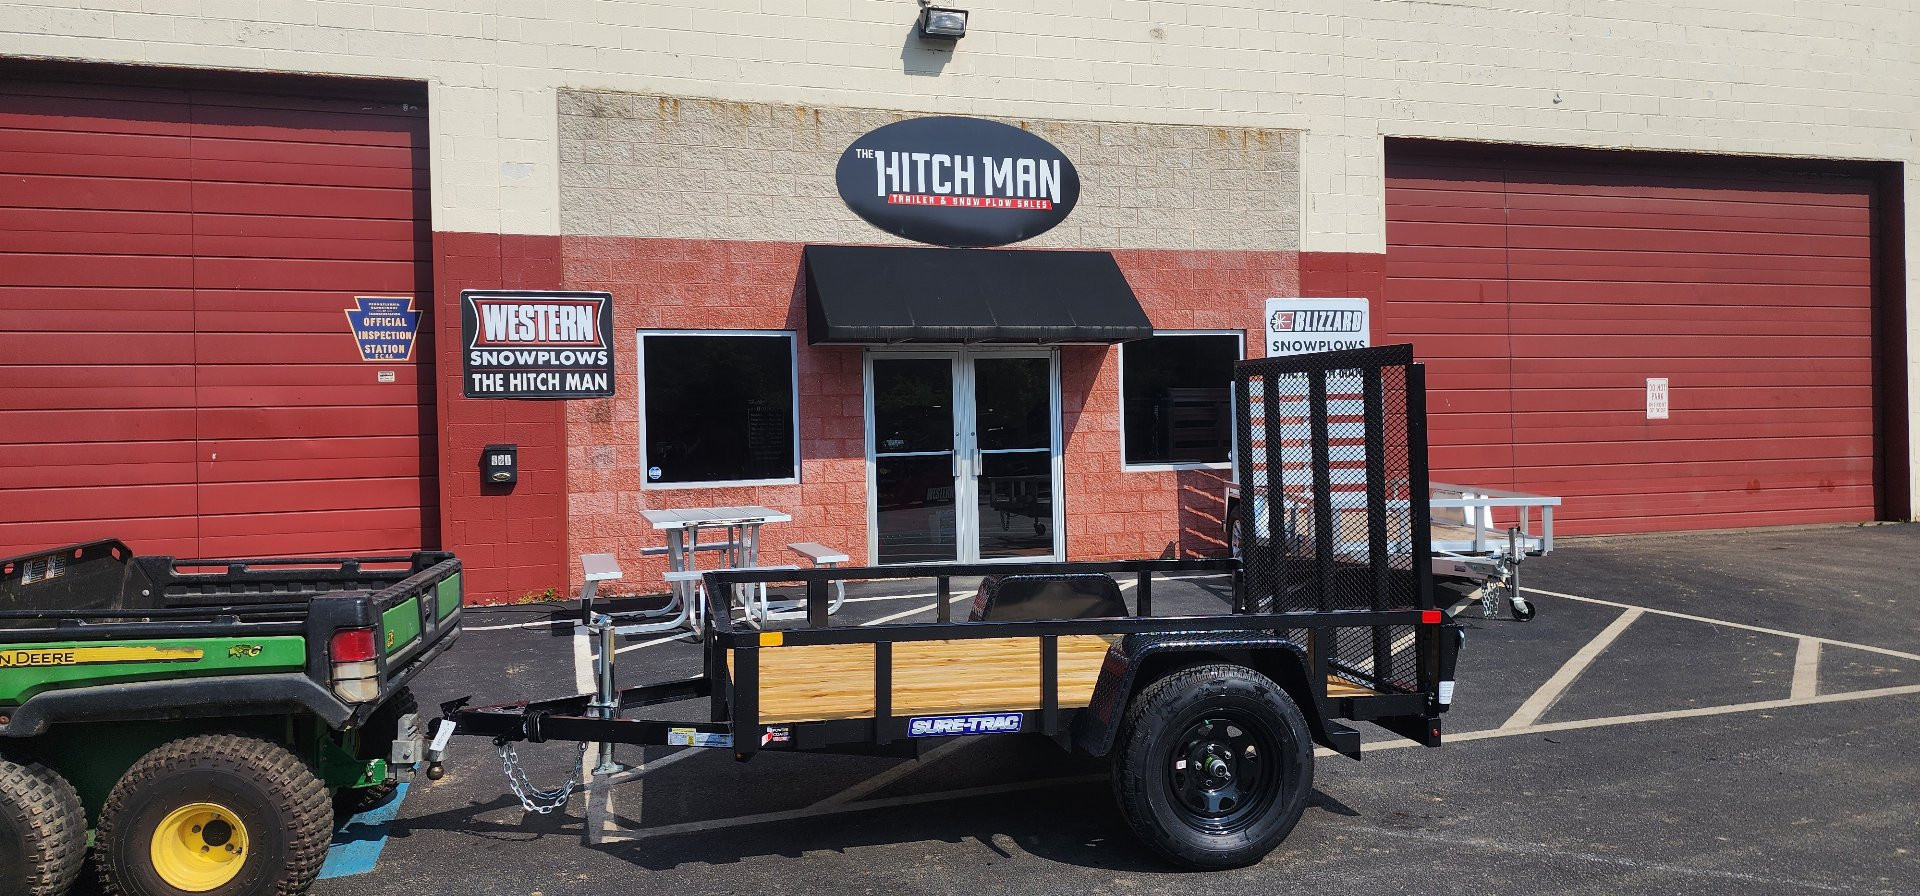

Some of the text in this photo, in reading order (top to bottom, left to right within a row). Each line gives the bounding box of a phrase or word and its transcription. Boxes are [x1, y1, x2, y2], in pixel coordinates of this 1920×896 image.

[856, 148, 1061, 203] THE HITCH MAN
[892, 194, 1048, 209] TRAILER & SNOW PLOW SALES
[363, 317, 407, 327] OFFICIAL
[481, 304, 594, 342] WESTERN
[1294, 311, 1362, 332] BLIZZARD
[358, 330, 412, 340] INSPECTION
[364, 344, 405, 354] STATION
[1272, 340, 1365, 352] SNOWPLOWS
[470, 350, 608, 366] SNOWPLOWS
[472, 372, 608, 392] THE HITCH MAN
[1651, 392, 1664, 400] PARK
[16, 651, 75, 664] DEERE
[911, 715, 1019, 735] SURE-TRAC
